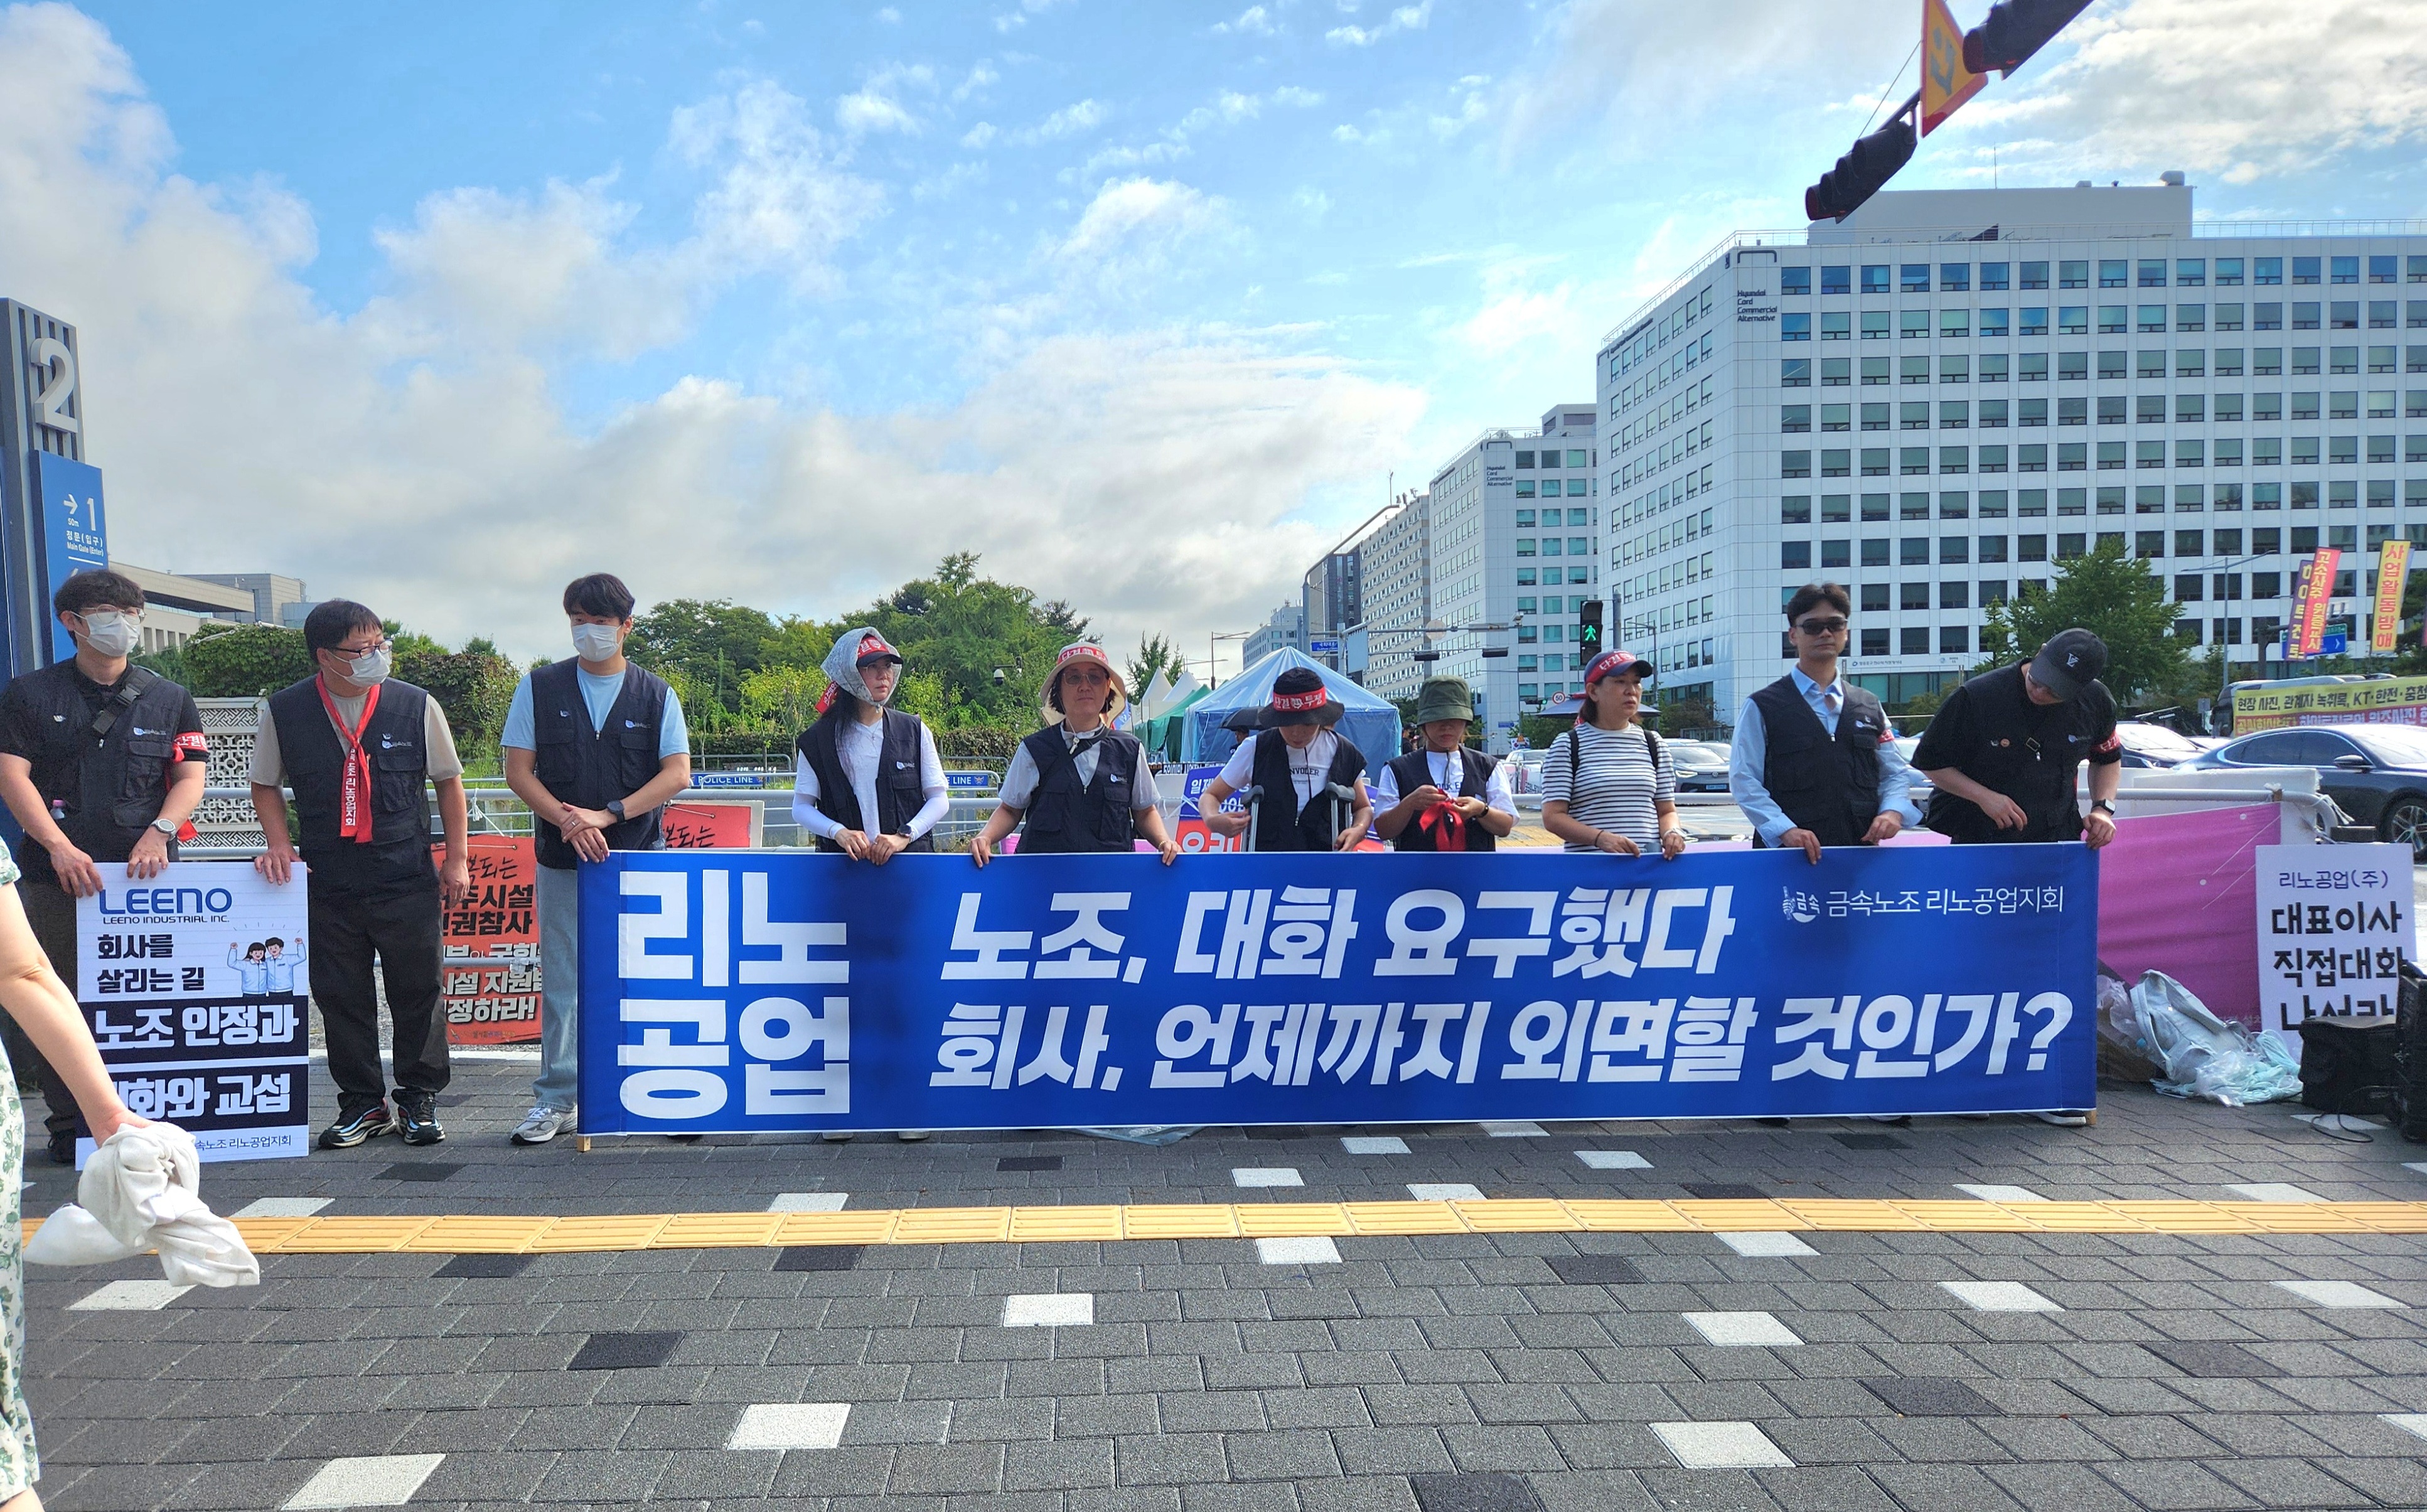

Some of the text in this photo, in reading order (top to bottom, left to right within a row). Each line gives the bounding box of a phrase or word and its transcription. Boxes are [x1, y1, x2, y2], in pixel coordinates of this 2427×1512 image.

[30, 337, 78, 433] 2
[87, 497, 96, 531] 1
[67, 542, 78, 551] Main
[78, 544, 89, 553] Gate
[1275, 692, 1322, 709] 단결 투쟁
[2237, 697, 2256, 711] 현장
[2258, 696, 2280, 710] 사진,
[2284, 694, 2314, 709] 관계자
[953, 776, 972, 785] LINE
[665, 823, 715, 847] 복되는
[468, 854, 518, 884] 복되는
[2279, 869, 2388, 889] 리노공업(주)
[1826, 886, 2064, 917] 금속노조 리노공업지회
[143, 916, 207, 924] INDUSTRIAL
[618, 869, 850, 987] 리노
[2271, 901, 2403, 935] 대표이사
[97, 934, 174, 960] 회사를
[941, 885, 1736, 984] 노조, 대화 요구했다
[97, 967, 205, 994] 살리는 길
[2273, 946, 2409, 987] 직접대화
[444, 995, 535, 1023] 정하라!
[95, 1004, 299, 1050] 노조 인정과
[930, 991, 2073, 1091] 회사, 언제까지 외면할 것인가?
[618, 997, 850, 1119] 공업
[215, 1073, 291, 1115] 교섭
[195, 1135, 291, 1152] 속노조 리노공업지회
